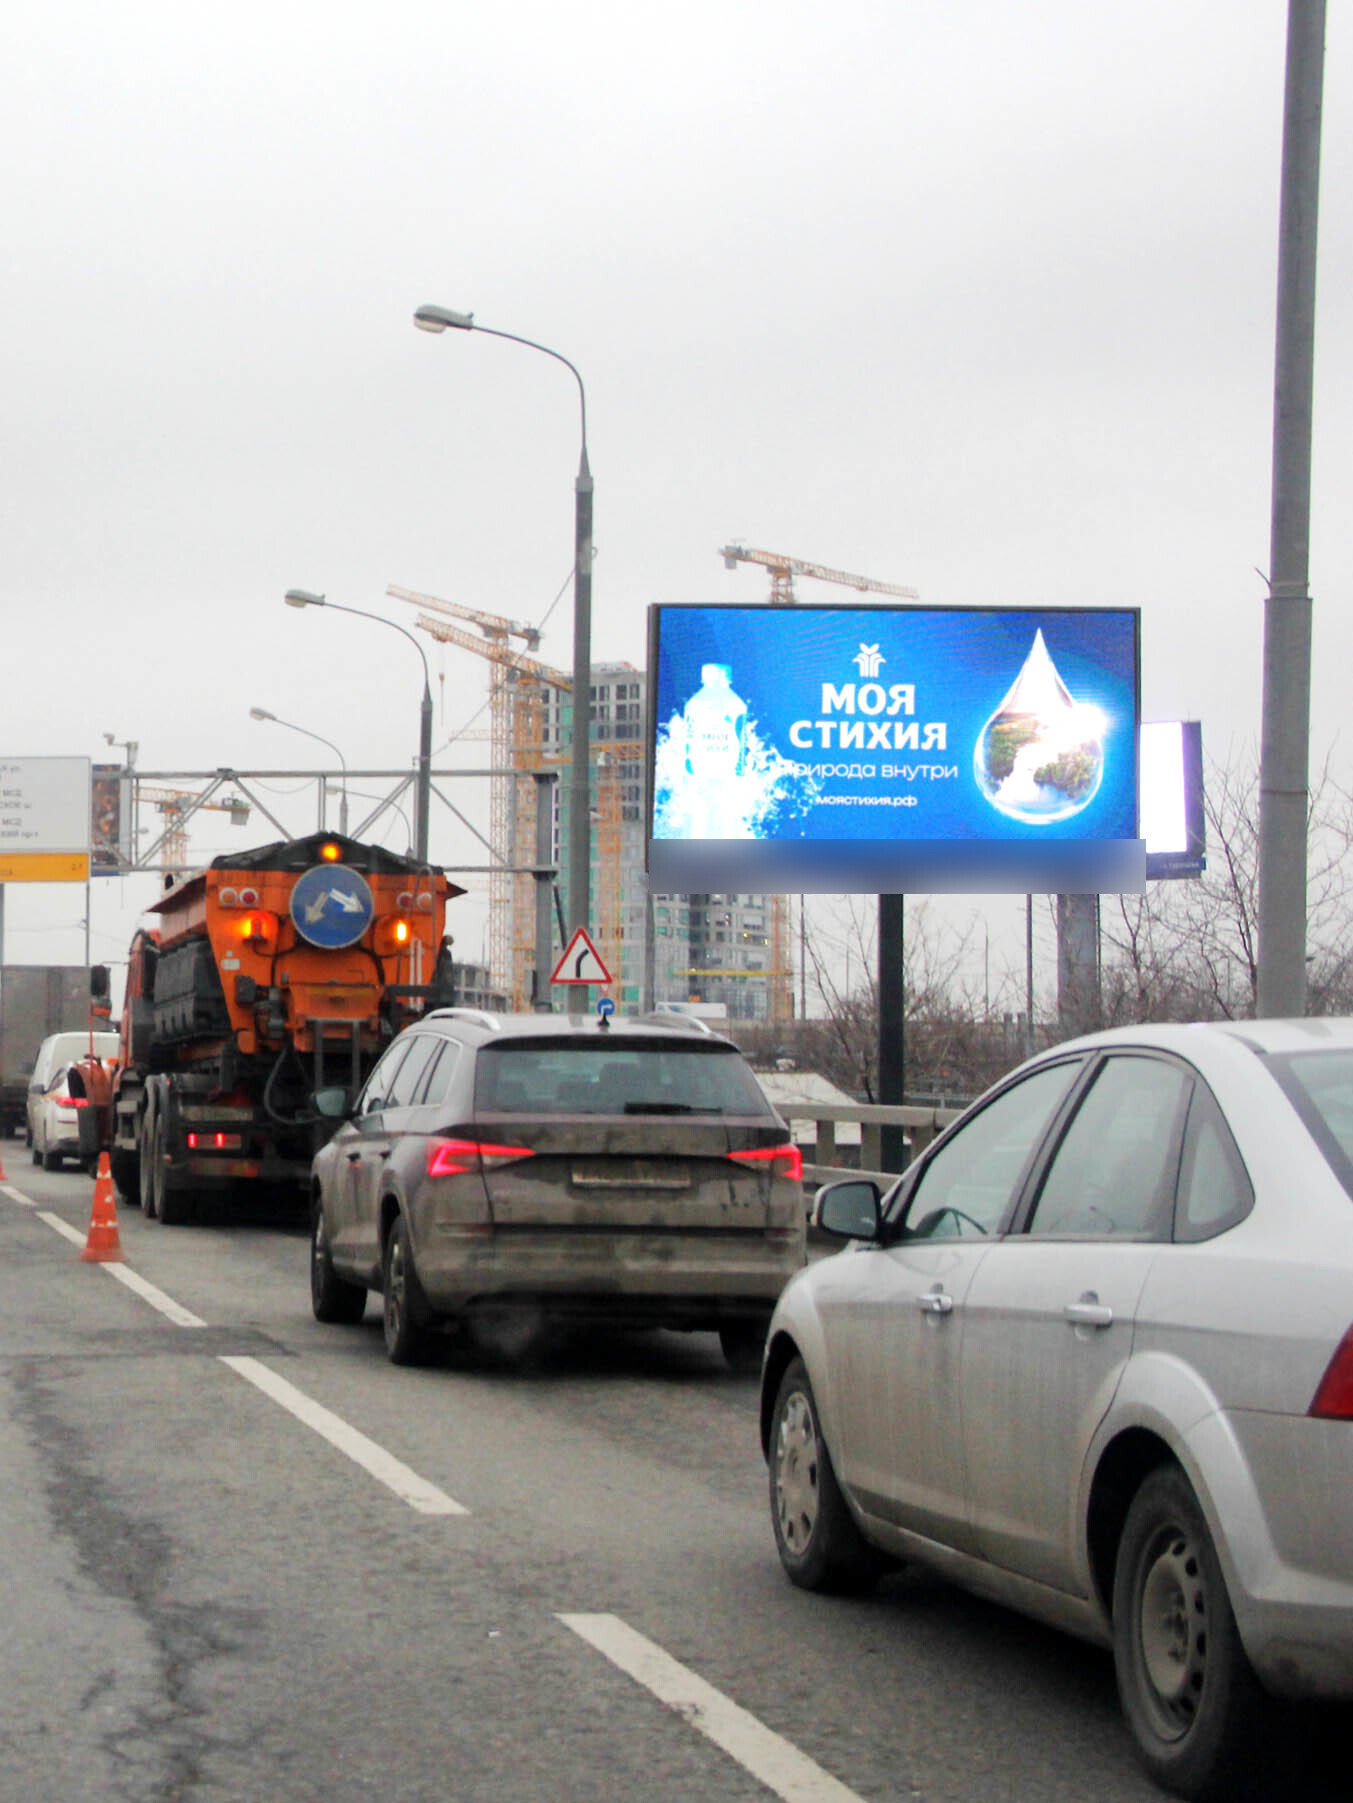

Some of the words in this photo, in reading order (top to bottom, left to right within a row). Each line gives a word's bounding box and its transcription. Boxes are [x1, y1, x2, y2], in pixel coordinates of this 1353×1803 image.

[821, 682, 916, 716] МОЯ
[789, 720, 947, 751] СТИХИЯ
[783, 762, 876, 780] рирода
[881, 763, 959, 781] внутри
[815, 794, 918, 808] моястихия.рф
